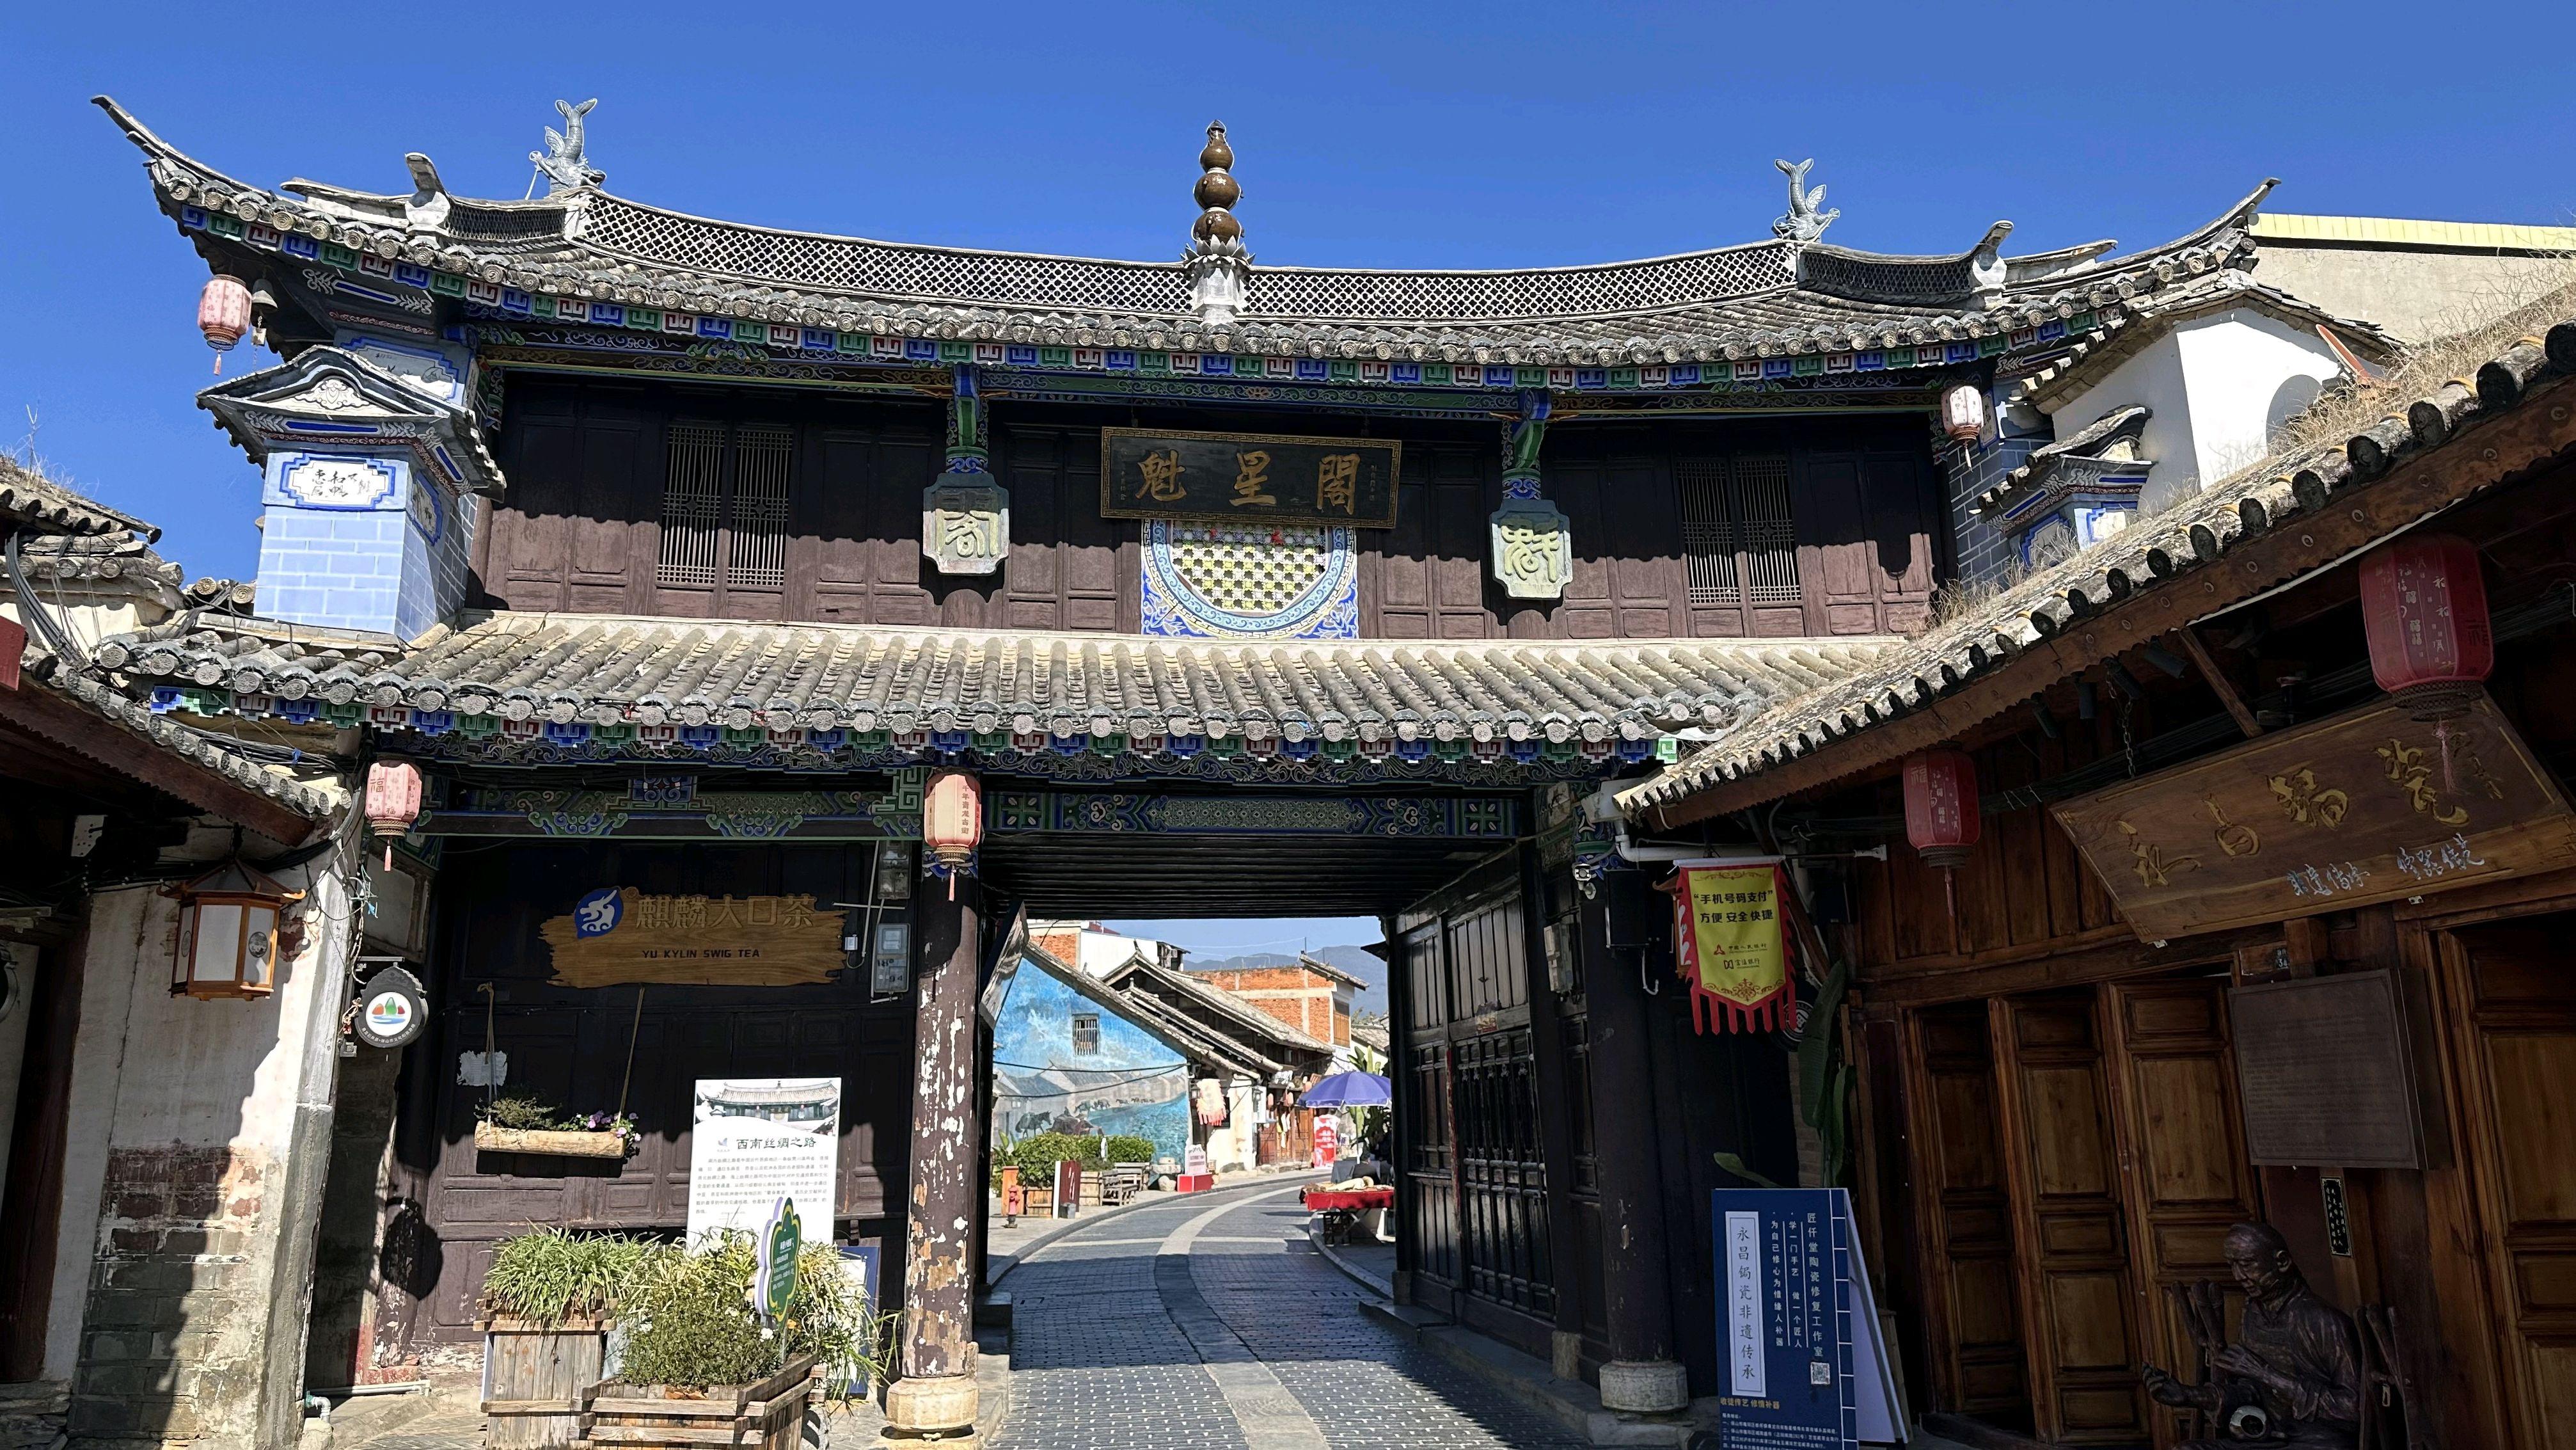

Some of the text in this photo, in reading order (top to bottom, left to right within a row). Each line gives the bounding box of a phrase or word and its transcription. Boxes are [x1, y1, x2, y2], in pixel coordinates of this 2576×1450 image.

[635, 893, 816, 929] 麒麟大口茶
[1700, 909, 1774, 923] 方便 安全 快捷
[642, 949, 760, 959] YU KYLIN SWIG TEA
[736, 1136, 817, 1150] 西南丝绸之路
